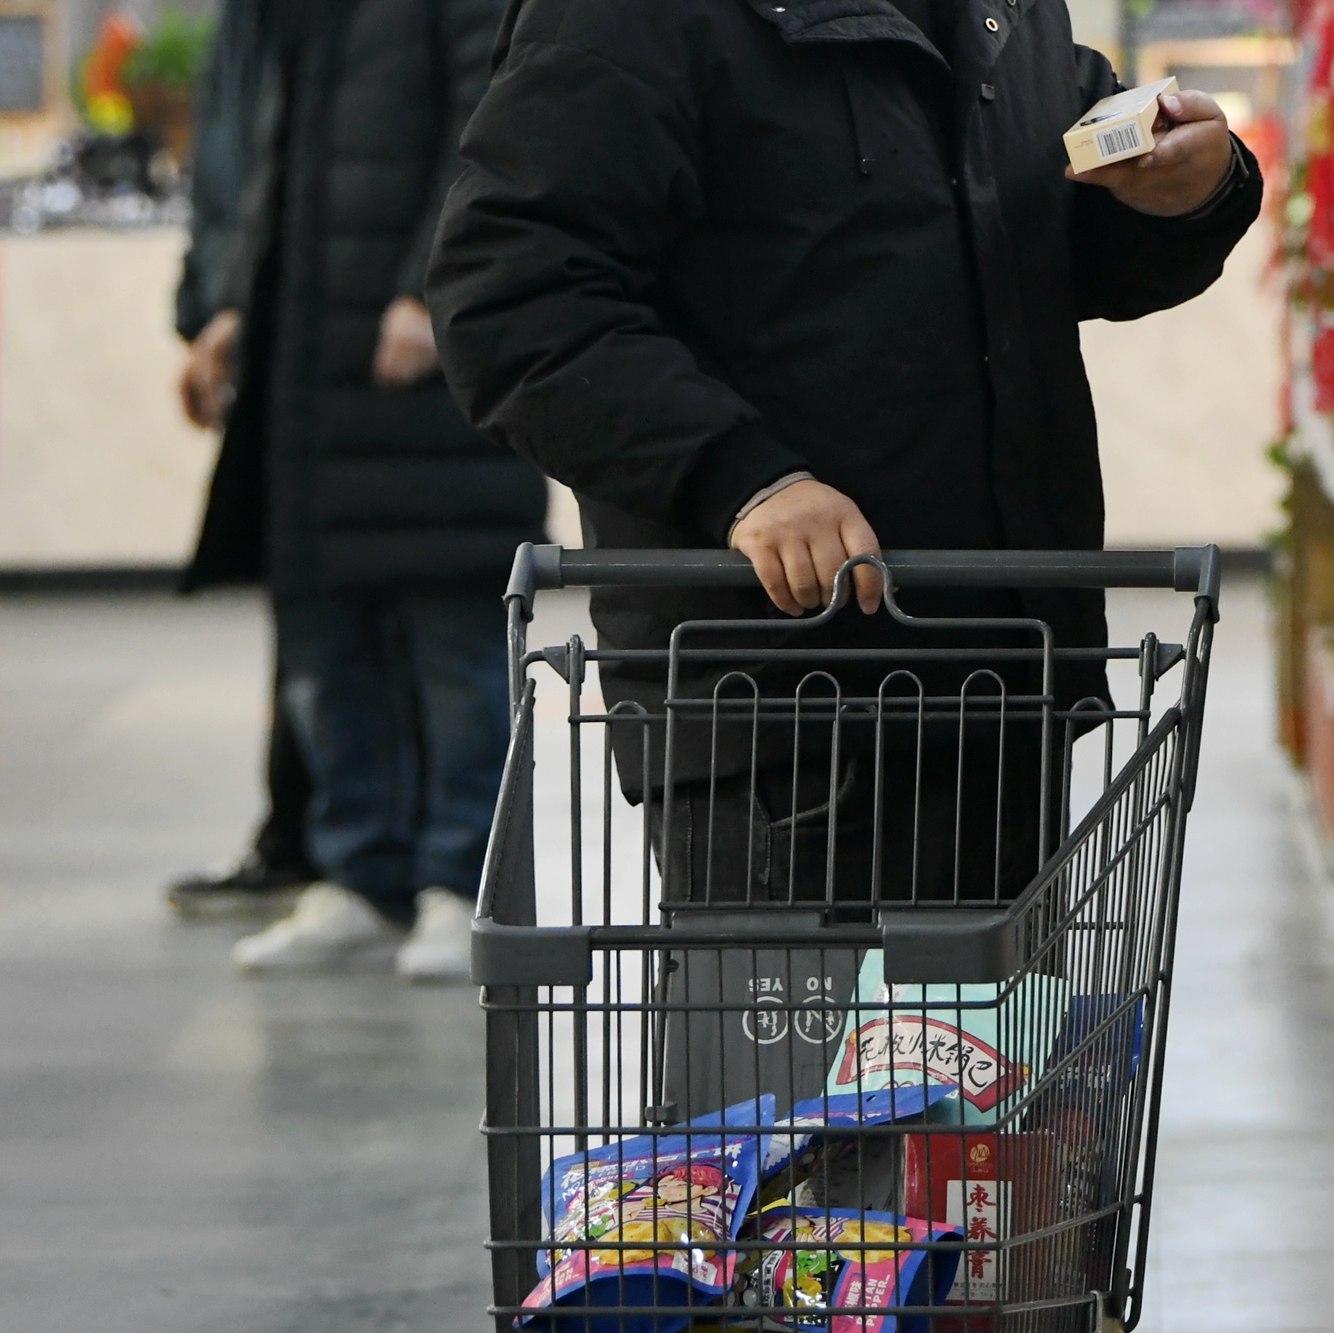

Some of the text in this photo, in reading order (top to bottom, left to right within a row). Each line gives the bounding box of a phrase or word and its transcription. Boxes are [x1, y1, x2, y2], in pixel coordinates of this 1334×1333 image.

[748, 977, 784, 992] YES
[806, 976, 833, 992] NO
[844, 1280, 862, 1320] 椒味
